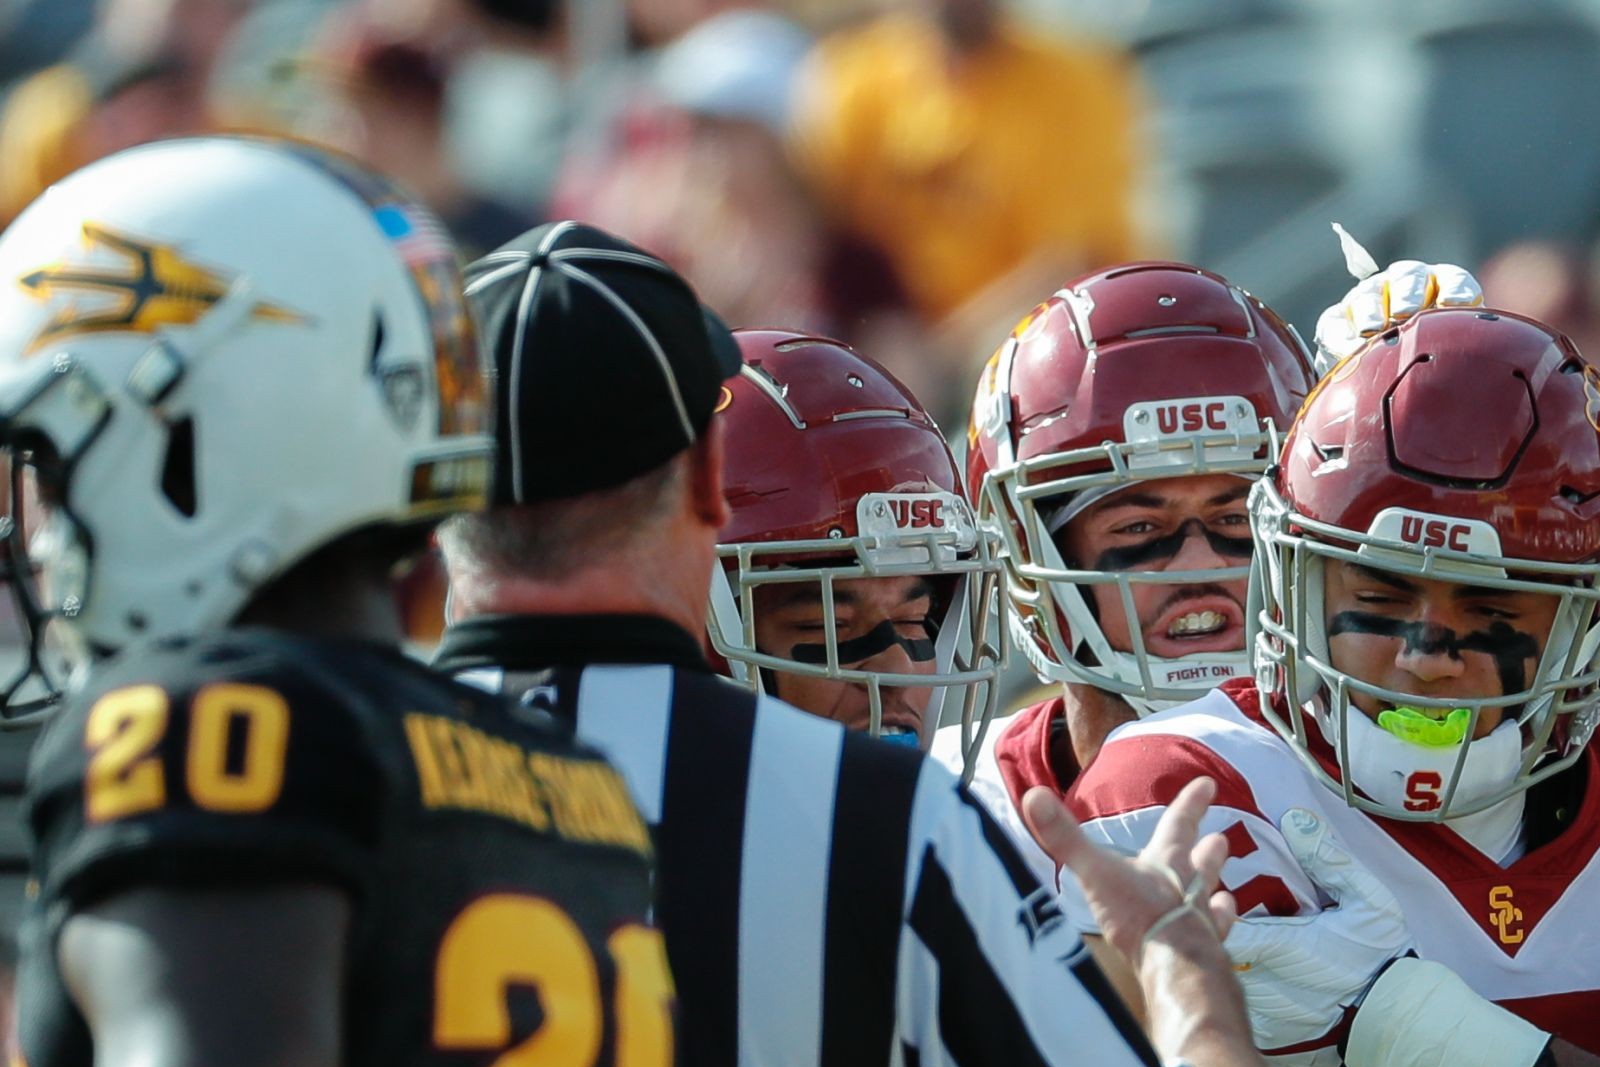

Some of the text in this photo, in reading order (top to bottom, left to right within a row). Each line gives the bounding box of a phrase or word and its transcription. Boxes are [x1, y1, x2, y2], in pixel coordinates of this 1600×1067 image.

[1156, 402, 1228, 434] USC
[888, 499, 945, 529] USC
[1400, 515, 1471, 553] USC
[1167, 665, 1234, 682] FIGHT ON!
[86, 682, 291, 823] 20
[1403, 771, 1443, 812] S
[1489, 884, 1523, 944] SC
